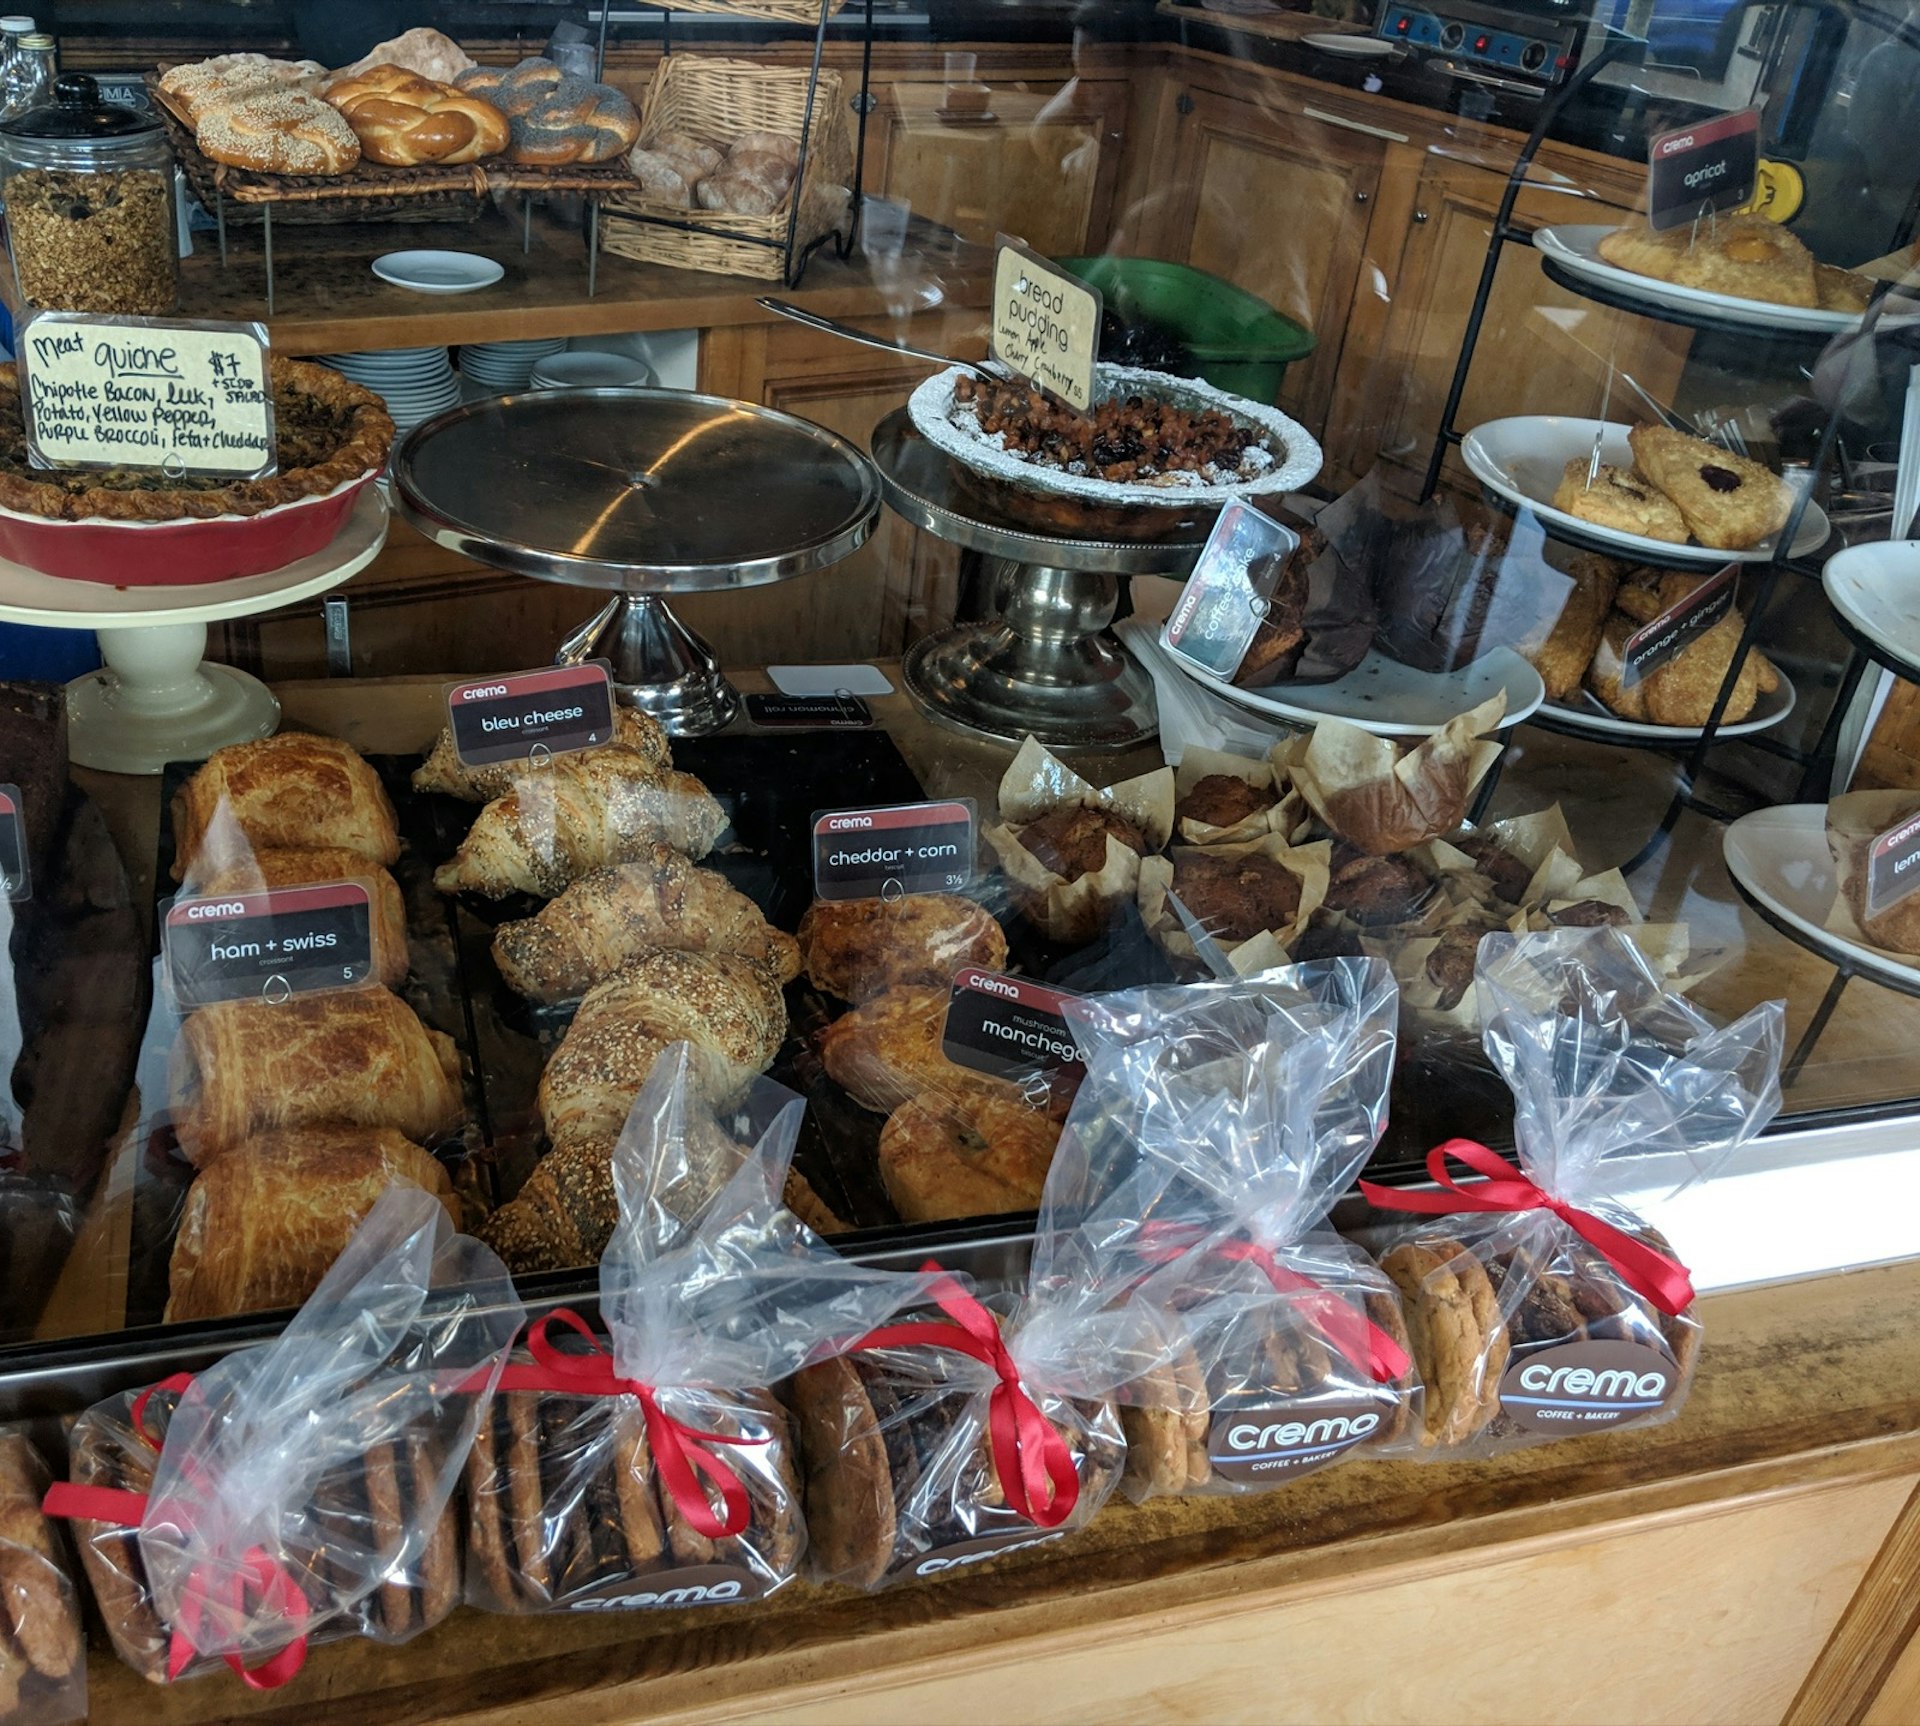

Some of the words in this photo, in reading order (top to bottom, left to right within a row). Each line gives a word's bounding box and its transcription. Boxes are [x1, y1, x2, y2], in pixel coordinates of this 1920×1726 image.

[1663, 135, 1694, 154] crema
[1684, 161, 1726, 188] apricot
[1020, 270, 1064, 315] bread
[1009, 299, 1068, 353] pudding
[32, 331, 84, 369] Meat
[94, 341, 179, 379] quiche
[208, 350, 241, 377] $7
[31, 373, 100, 406] Chipotle
[1273, 551, 1283, 563] 4
[1171, 595, 1197, 636] crema
[1204, 582, 1236, 641] coffee
[1638, 615, 1671, 641] crema
[1633, 629, 1679, 666] orange
[463, 685, 508, 700] crema
[482, 716, 519, 732] bleu
[523, 706, 583, 726] cheese
[588, 732, 598, 743] 4
[829, 815, 873, 830] crema
[1887, 820, 1920, 847] crem
[829, 848, 902, 867] cheddar
[905, 847, 914, 858] +
[918, 844, 957, 859] corn
[187, 902, 246, 919] crema
[211, 942, 260, 961] ham
[265, 940, 277, 951] +
[283, 932, 337, 952] swiss
[343, 967, 353, 980] 5
[970, 974, 1019, 999] crema
[1012, 1014, 1067, 1038] mushroom
[982, 1019, 1087, 1063] manchego
[1519, 1364, 1667, 1398] crema
[1536, 1409, 1574, 1420] COFFEE
[1584, 1411, 1621, 1421] BAKERY
[1228, 1413, 1380, 1451] crema
[1251, 1458, 1292, 1472] COFFEE
[1301, 1449, 1339, 1465] BAKERY
[571, 1580, 742, 1609] crema
